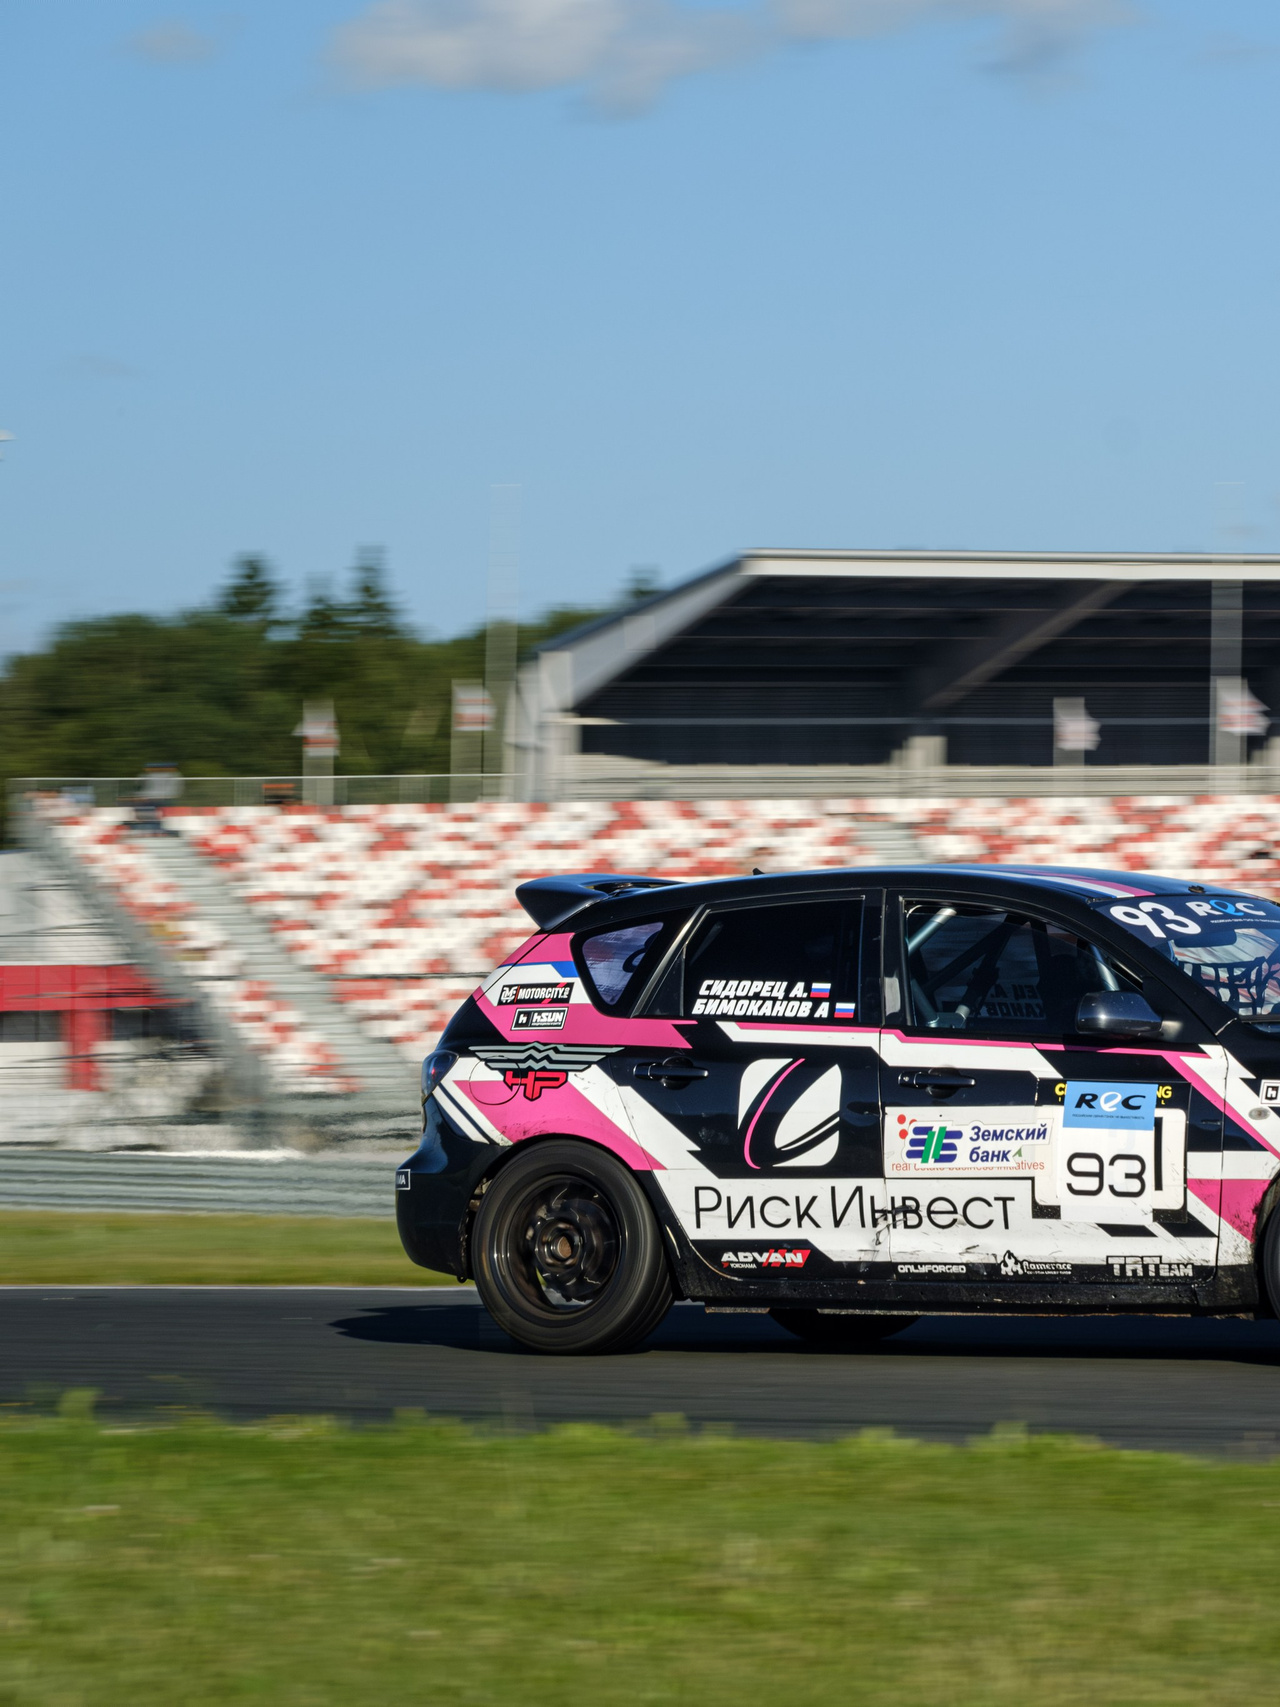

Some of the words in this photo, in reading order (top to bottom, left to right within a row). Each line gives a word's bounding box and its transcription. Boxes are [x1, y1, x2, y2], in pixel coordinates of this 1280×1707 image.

[1109, 901, 1202, 938] 93
[517, 987, 565, 999] MOTORCITY
[699, 979, 788, 999] СИДОРЕЦ
[789, 981, 808, 998] А.
[691, 998, 813, 1018] БИМОКАНОВ
[813, 1001, 830, 1018] А
[969, 1123, 1048, 1142] Земский
[969, 1146, 1012, 1163] банк
[1066, 1152, 1146, 1198] 93
[721, 1251, 803, 1263] ADVAN
[898, 1264, 967, 1274] ONLYFORGED
